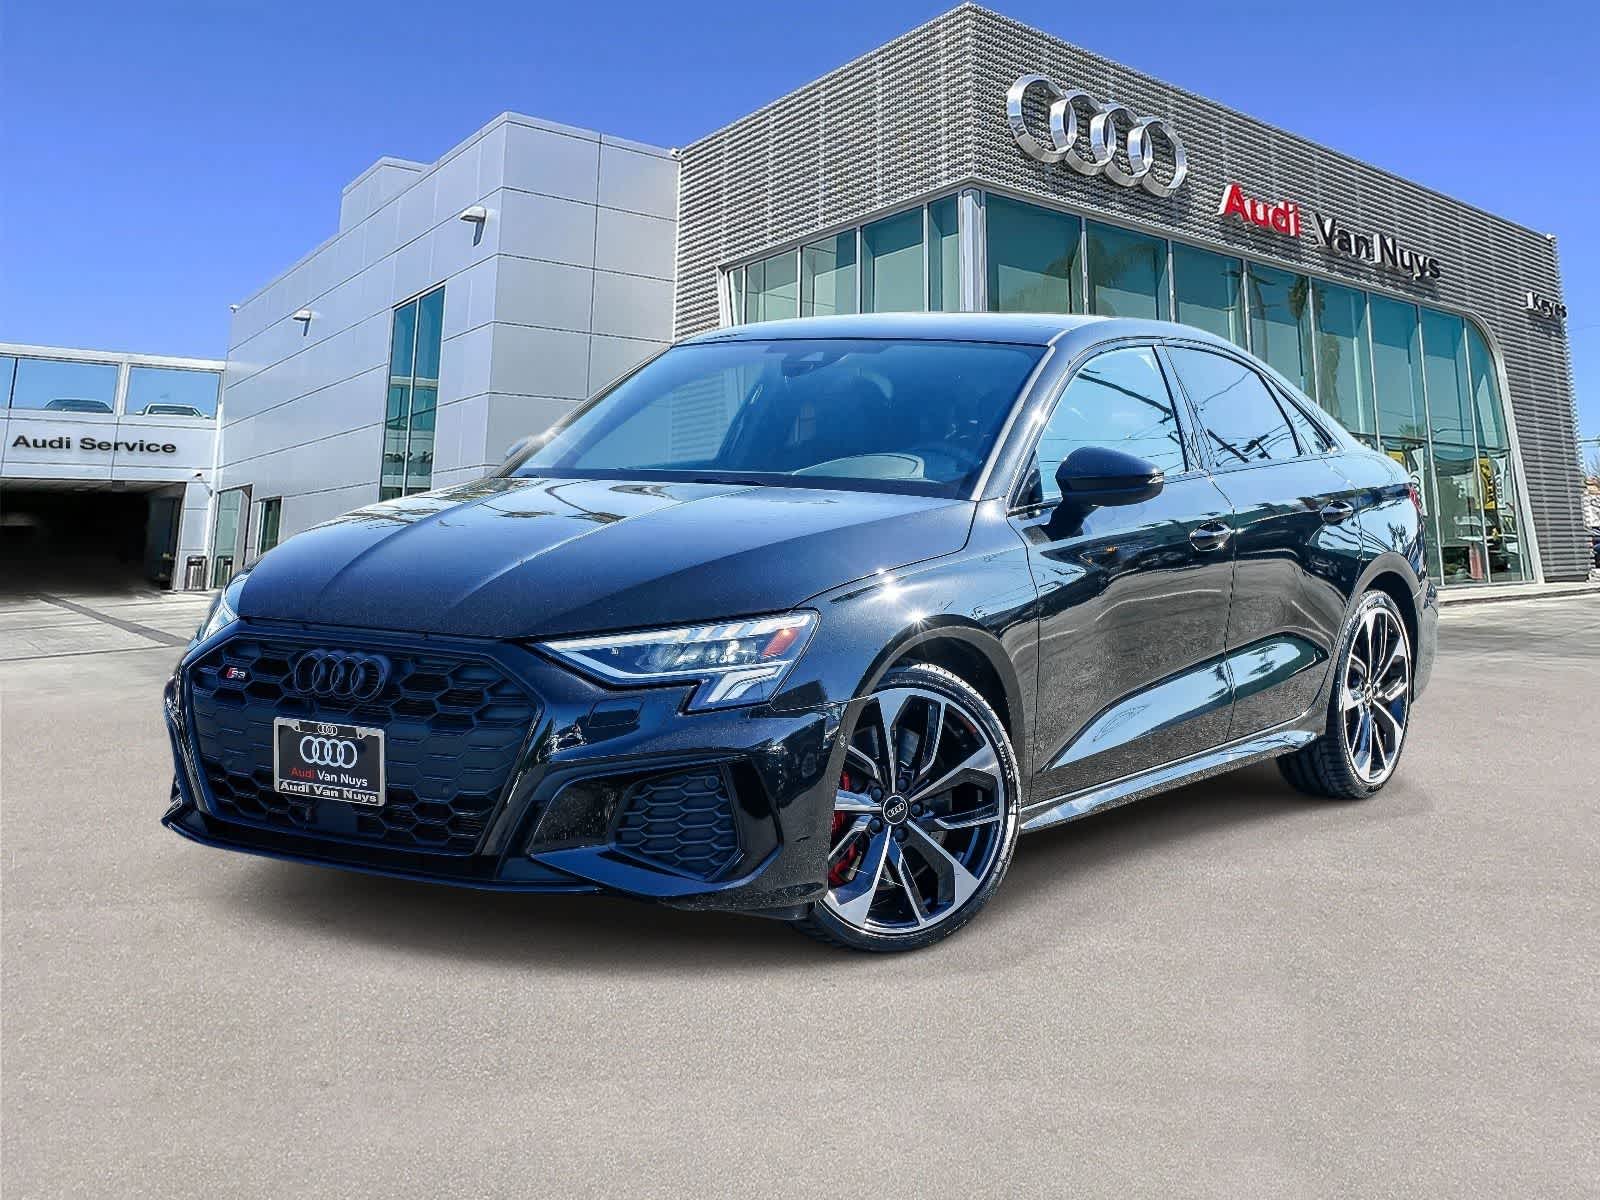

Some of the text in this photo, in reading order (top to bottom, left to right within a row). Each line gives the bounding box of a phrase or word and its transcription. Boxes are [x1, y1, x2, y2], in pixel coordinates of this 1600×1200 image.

[1217, 182, 1441, 281] Audi Van Nuys
[1526, 291, 1567, 319] Keyes
[12, 434, 177, 454] Audi Service
[290, 767, 368, 788] Audi Van Nuys
[280, 781, 377, 803] Audi Van Nuys
